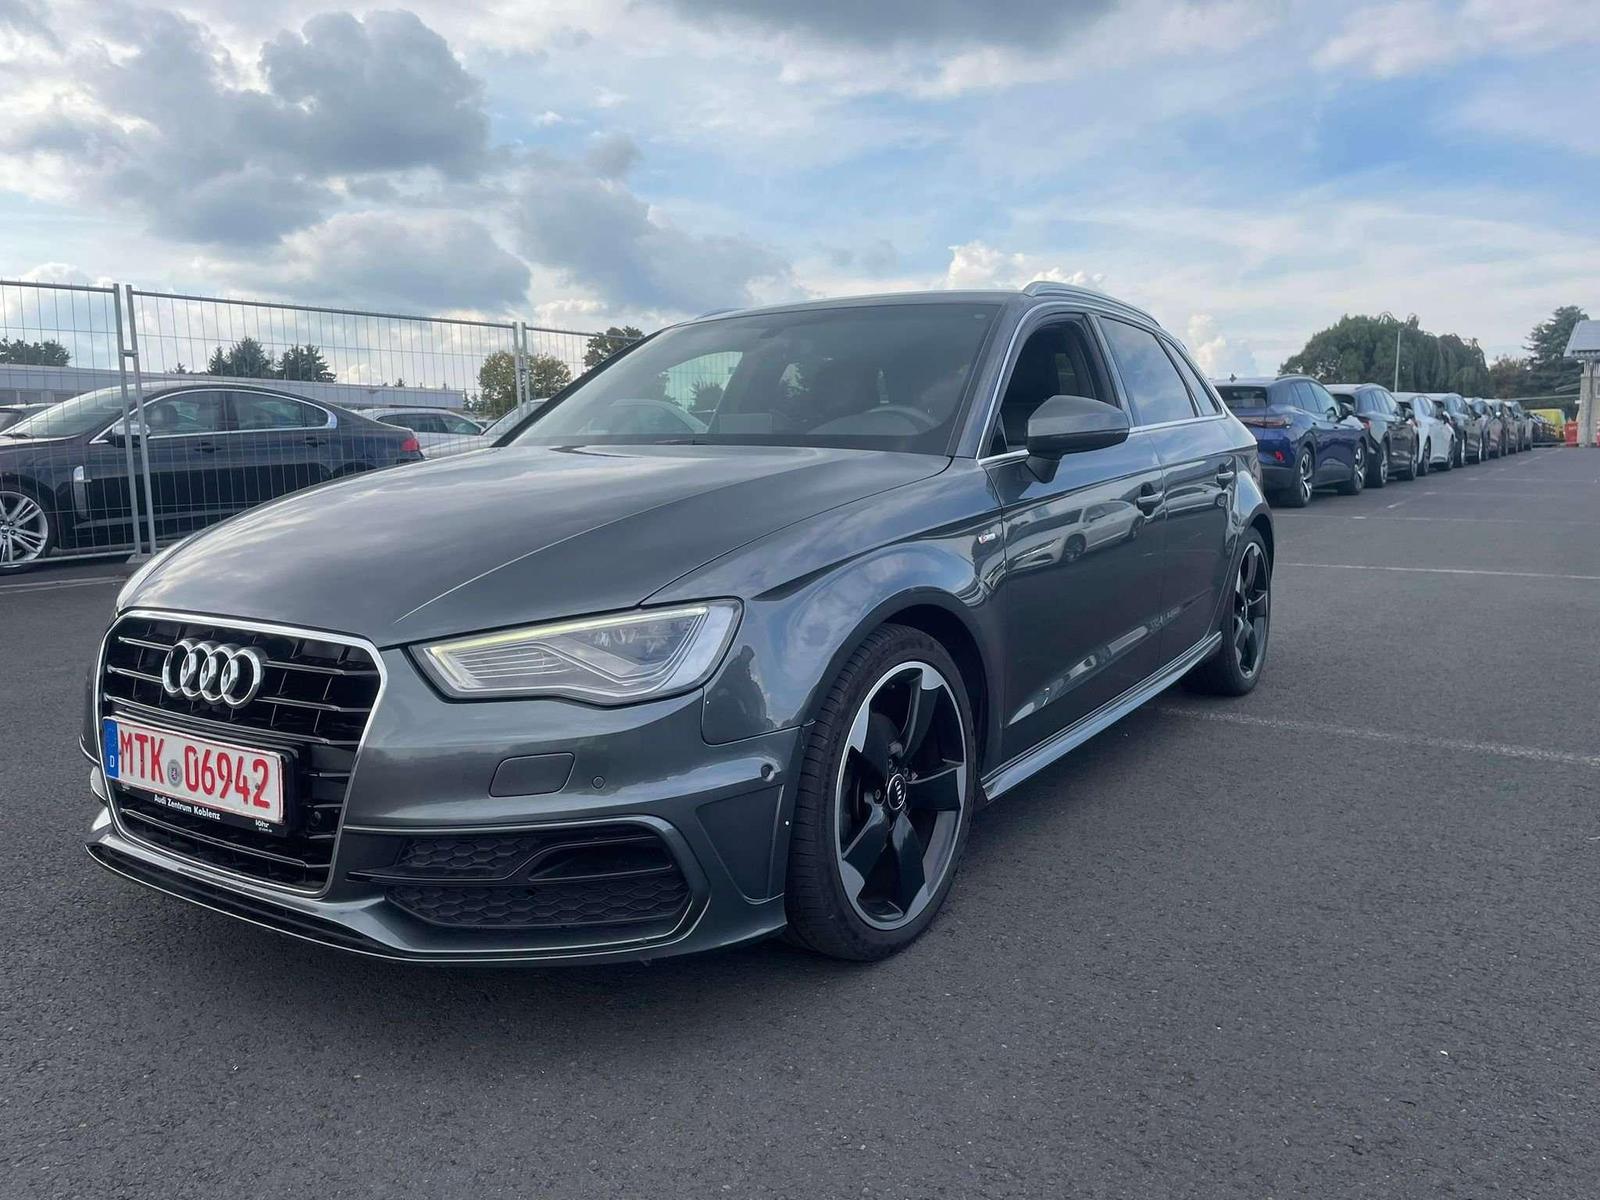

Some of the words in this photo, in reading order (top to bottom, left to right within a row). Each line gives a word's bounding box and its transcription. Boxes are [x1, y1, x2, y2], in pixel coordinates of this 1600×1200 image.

[109, 755, 115, 768] D
[119, 730, 165, 784] MTK
[184, 745, 271, 809] 06942
[154, 794, 167, 805] Audi
[167, 798, 192, 813] Zentrum
[193, 806, 221, 820] Koblenz
